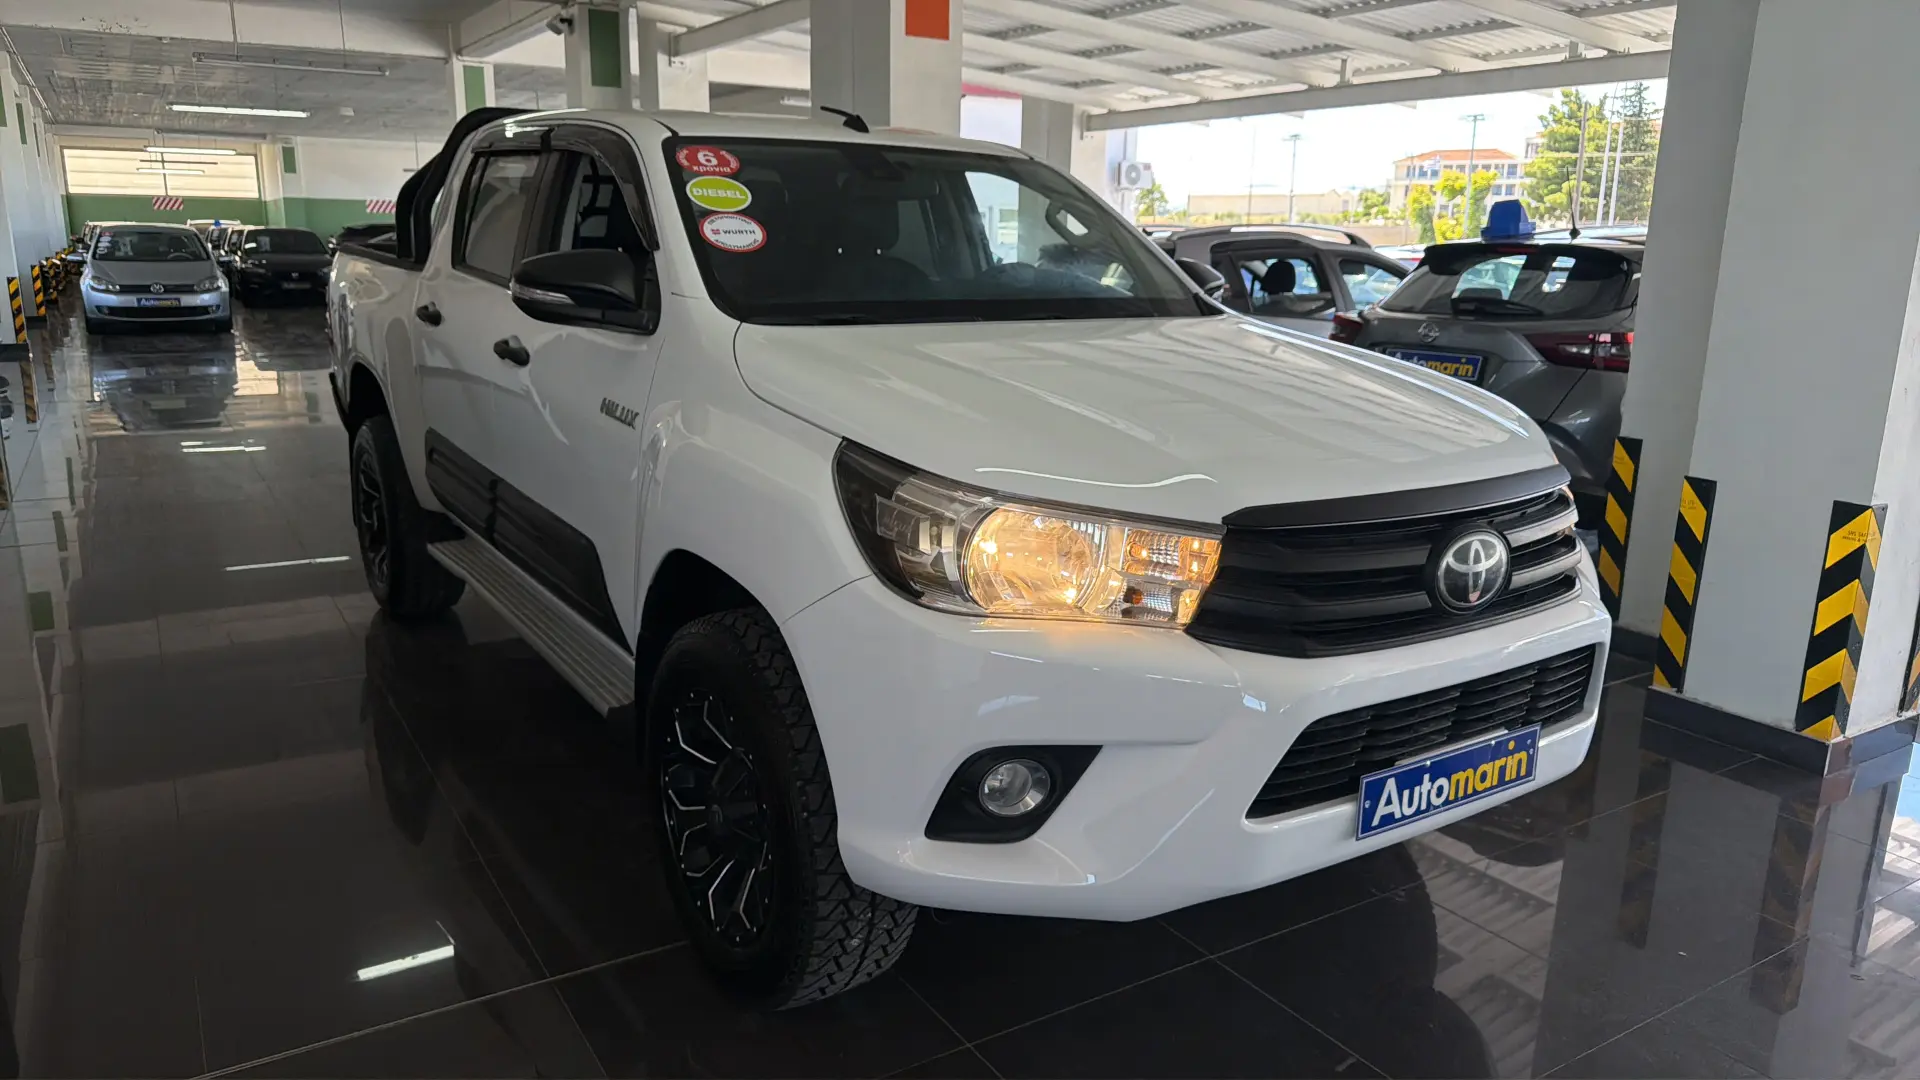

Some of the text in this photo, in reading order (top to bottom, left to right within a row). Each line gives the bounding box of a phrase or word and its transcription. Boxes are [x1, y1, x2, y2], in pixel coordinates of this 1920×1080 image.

[697, 150, 718, 166] 6
[692, 187, 746, 199] DIESEL
[1394, 352, 1474, 377] marin
[1370, 739, 1528, 827] Automarin
